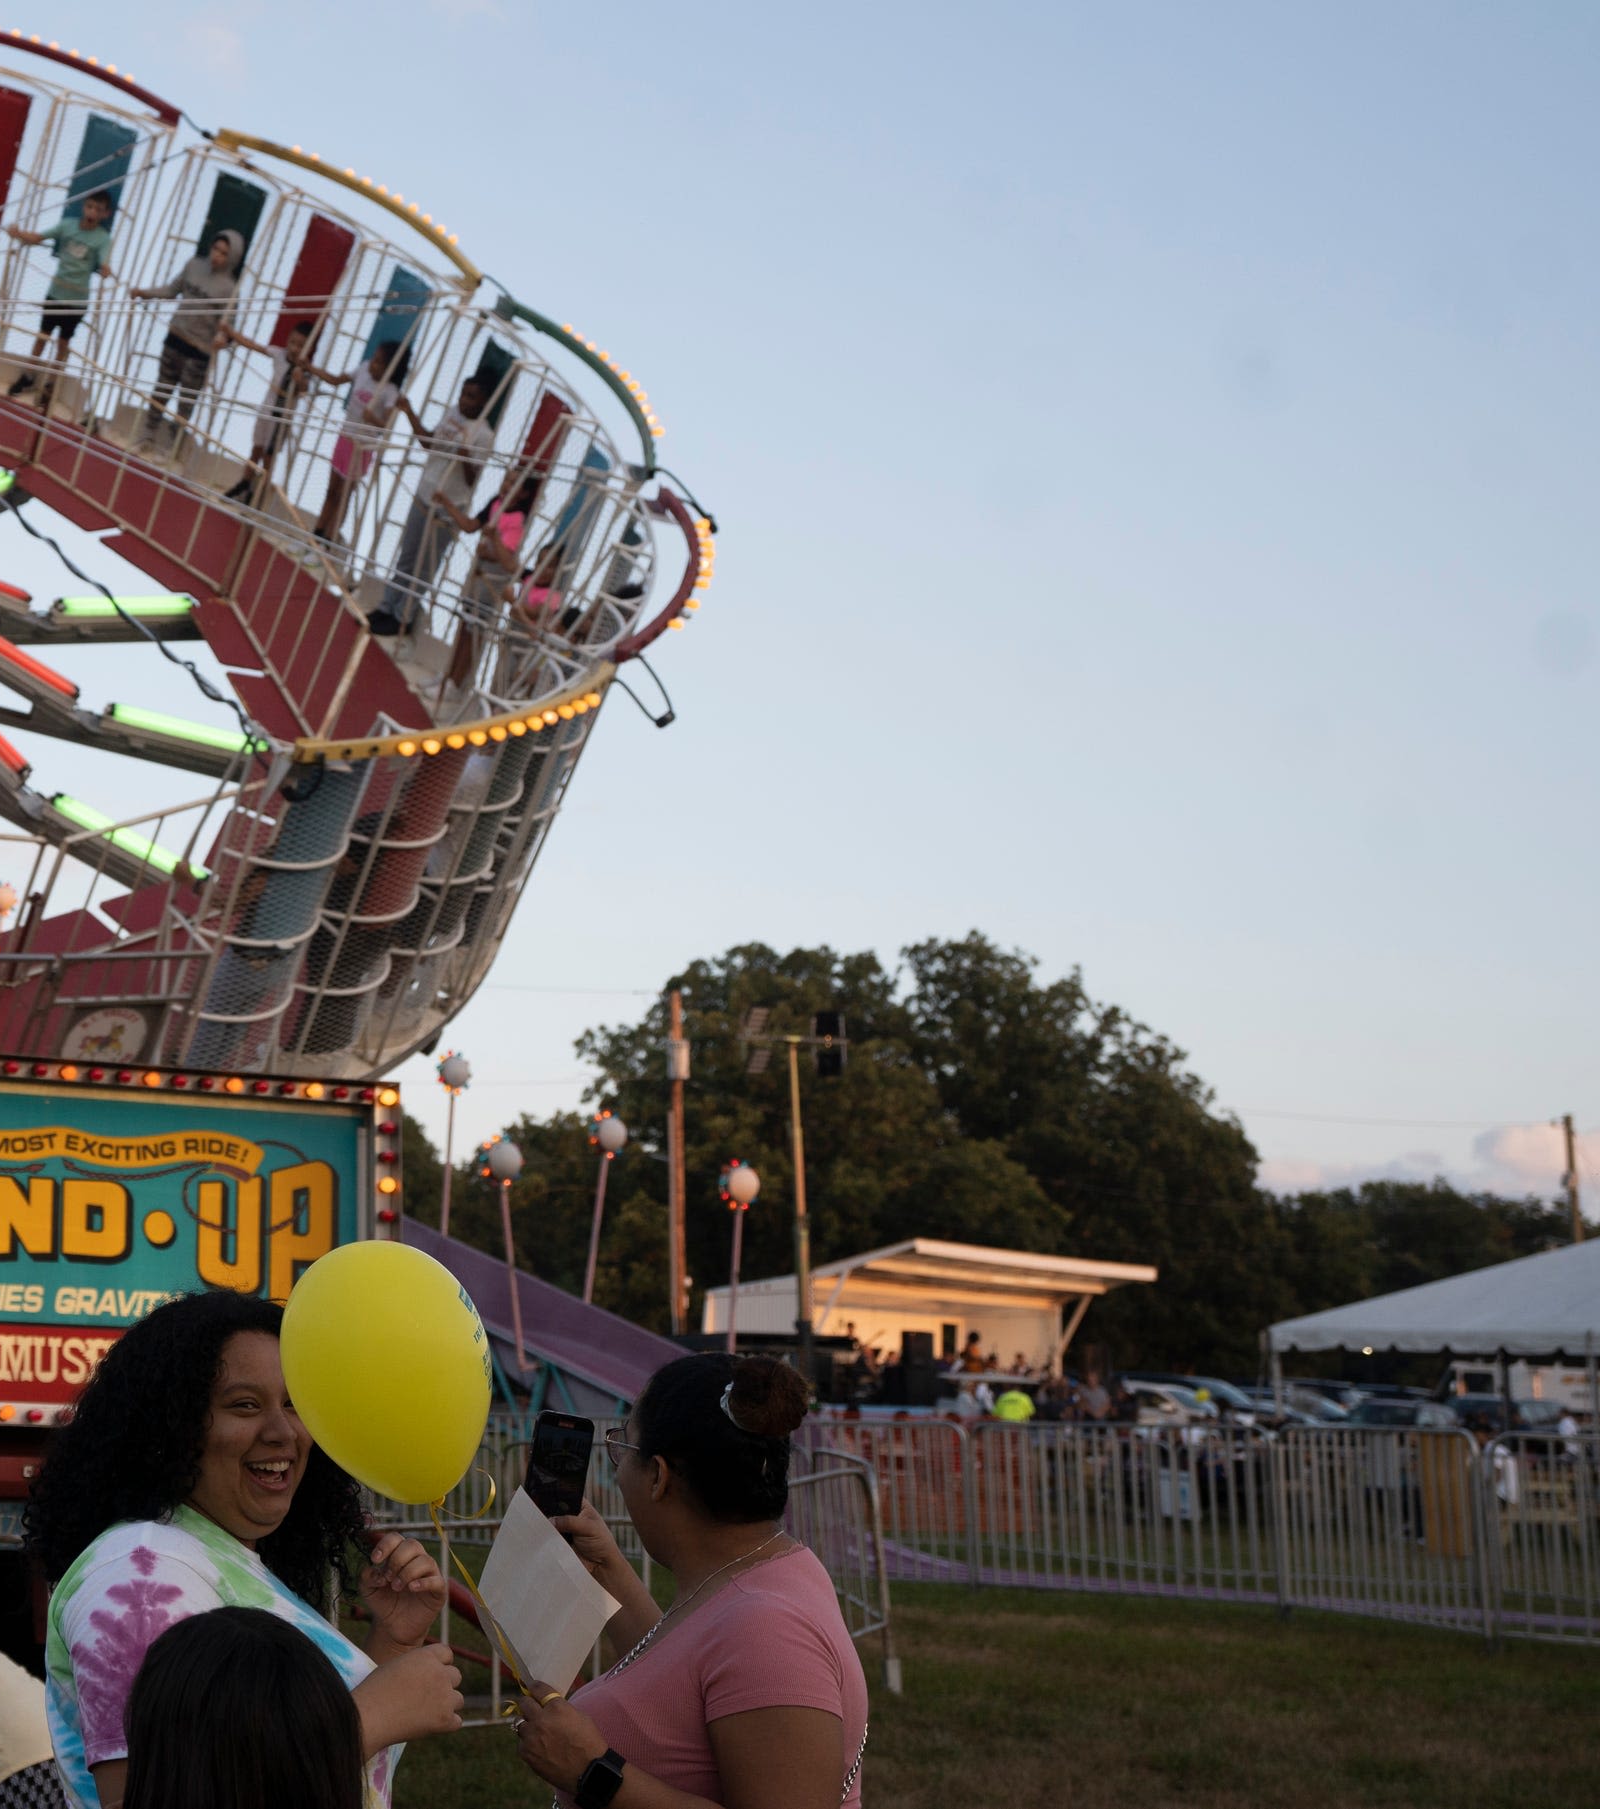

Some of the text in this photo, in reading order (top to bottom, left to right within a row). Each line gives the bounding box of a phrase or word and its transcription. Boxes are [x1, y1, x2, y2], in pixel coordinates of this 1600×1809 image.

[65, 1134, 177, 1161] EXCITING
[184, 1138, 249, 1163] RIDE!
[55, 1287, 184, 1318] GRAVIT
